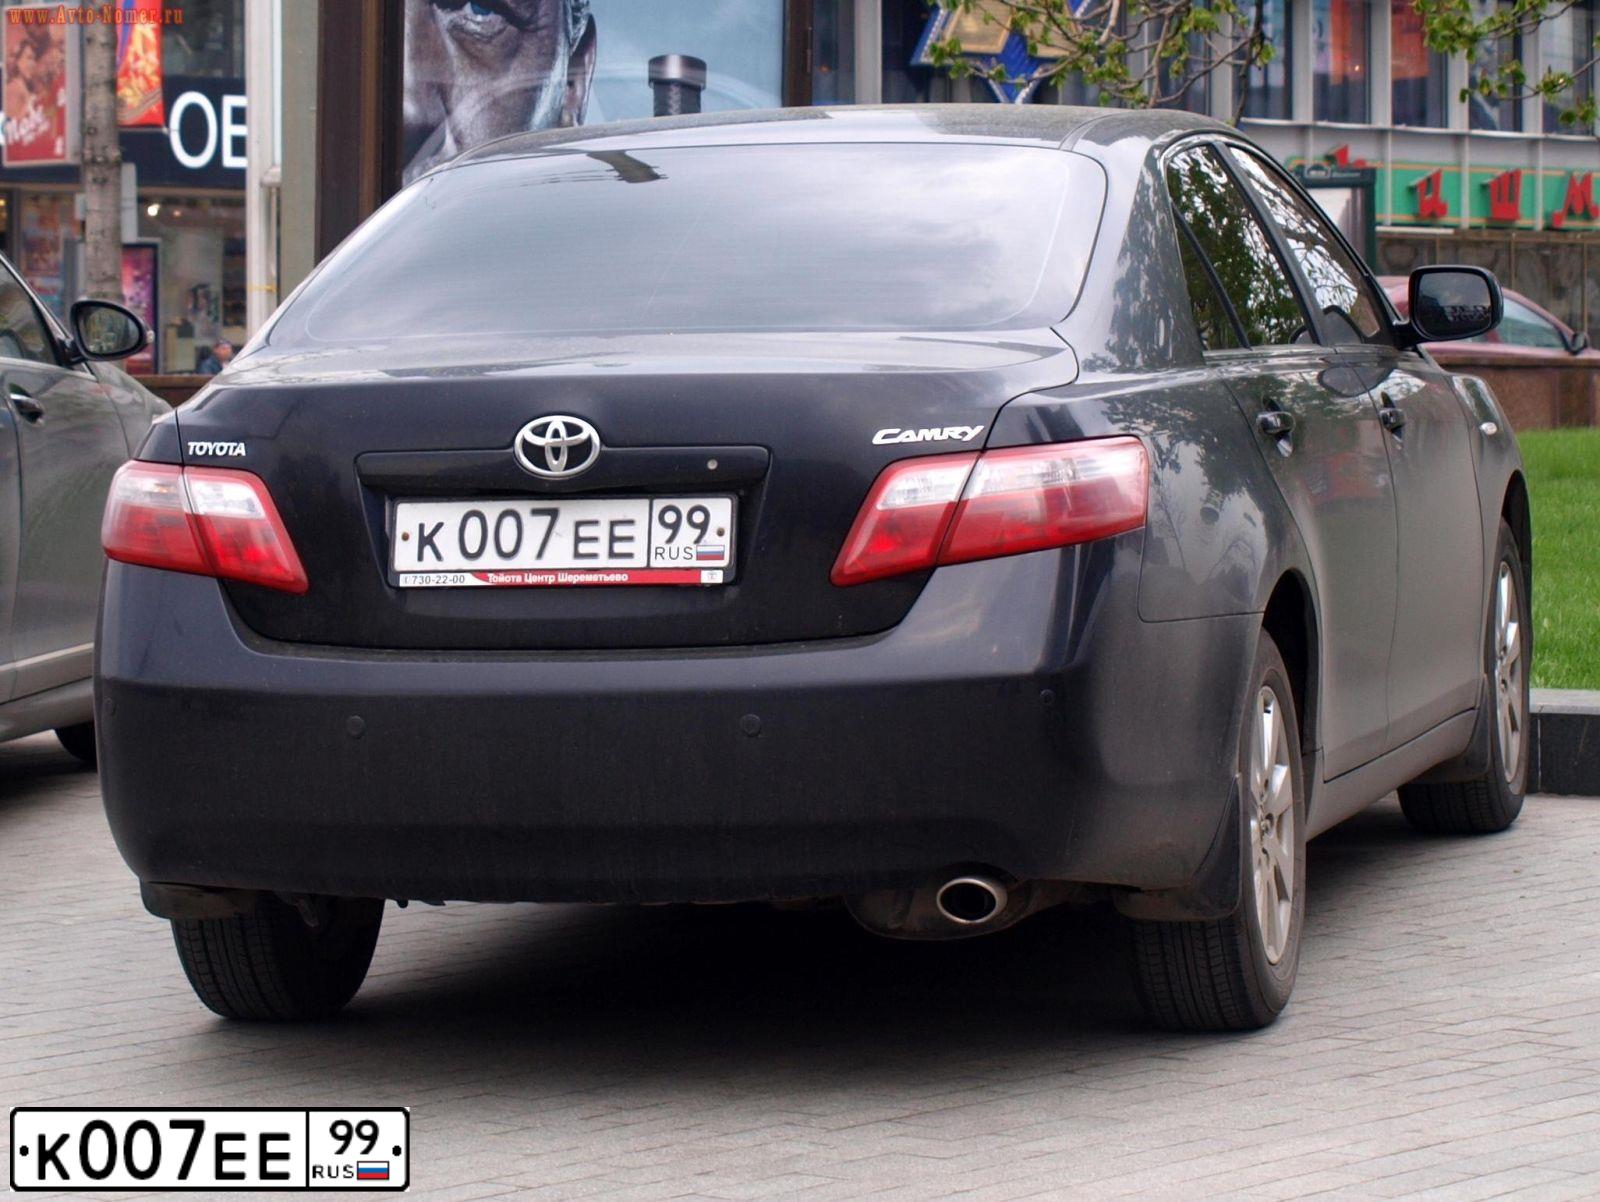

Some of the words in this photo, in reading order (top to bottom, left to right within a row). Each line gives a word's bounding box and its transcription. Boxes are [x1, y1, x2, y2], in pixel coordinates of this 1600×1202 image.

[872, 425, 984, 445] CAMRY
[187, 441, 246, 456] TOYOTA
[658, 504, 711, 545] 99
[654, 546, 694, 561] RUS
[524, 572, 556, 585] Центр
[557, 572, 629, 584] Шереметьево
